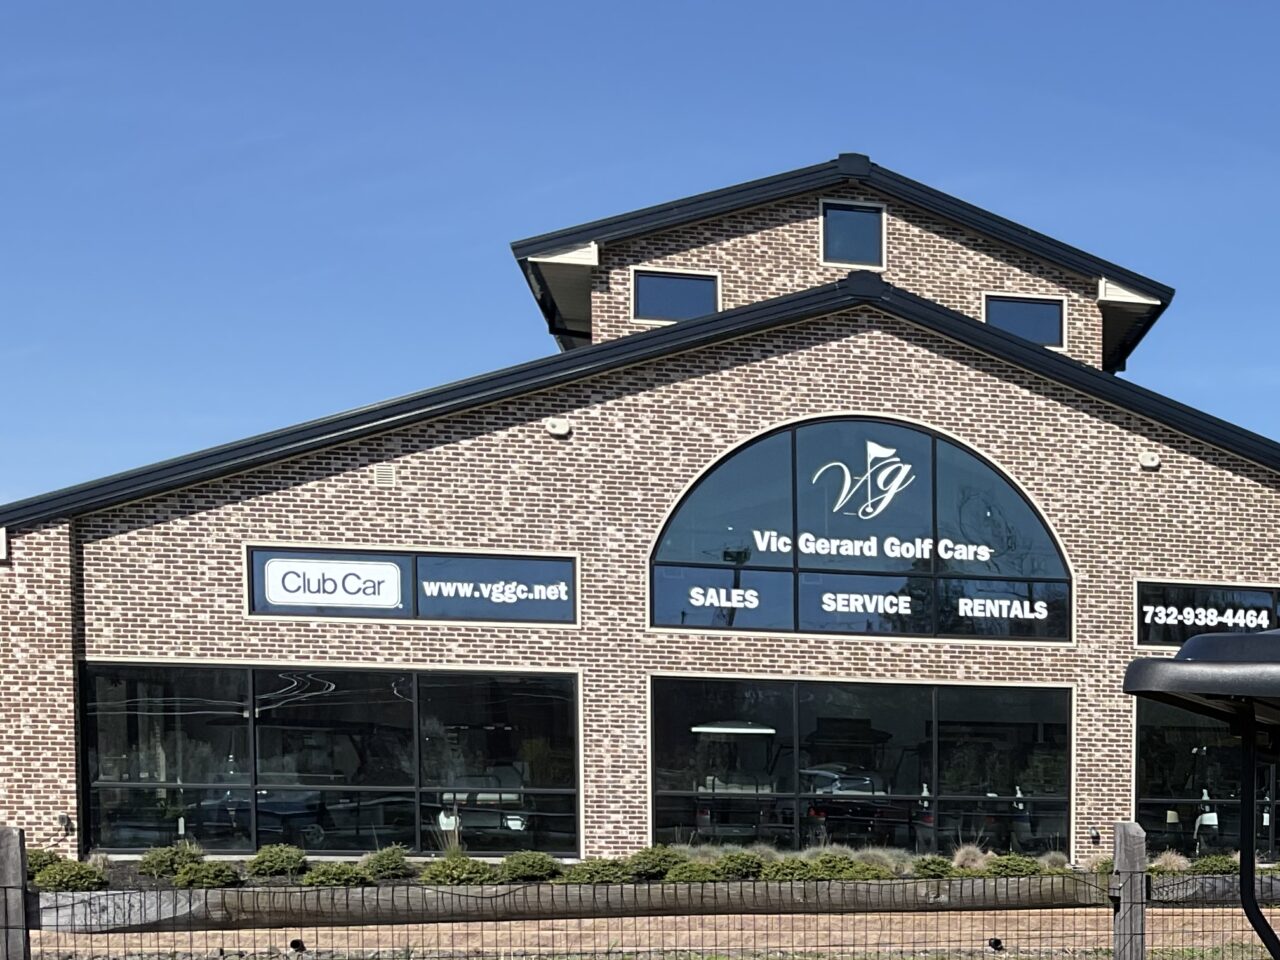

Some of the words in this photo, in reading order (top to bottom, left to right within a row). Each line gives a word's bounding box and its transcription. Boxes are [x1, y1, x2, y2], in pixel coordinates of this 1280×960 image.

[753, 530, 791, 553] Vic
[798, 535, 877, 557] Gerard
[883, 537, 933, 560] Golf
[937, 538, 992, 562] Cars
[281, 570, 338, 596] Club
[341, 572, 386, 597] Car
[422, 579, 569, 603] www.vggc.net
[689, 586, 759, 609] SALES
[822, 592, 911, 615] SERVICE
[958, 598, 1048, 620] RENTALS
[1142, 605, 1270, 629] 732-938-4464
